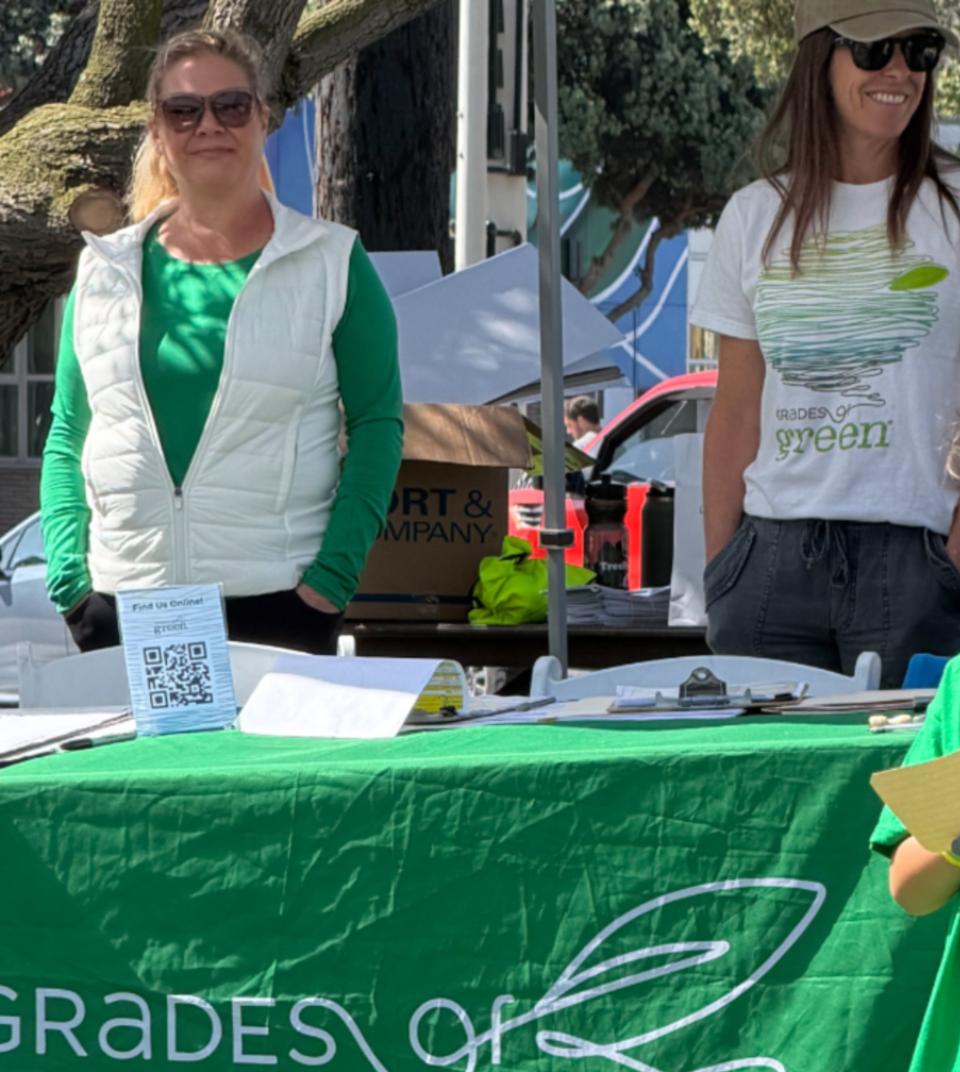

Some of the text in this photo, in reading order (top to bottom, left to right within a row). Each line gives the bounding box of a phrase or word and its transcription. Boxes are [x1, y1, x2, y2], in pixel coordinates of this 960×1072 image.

[775, 420, 891, 461] green
[463, 489, 493, 519] &
[376, 521, 494, 544] MPANY
[132, 597, 203, 612] Find Us Online!
